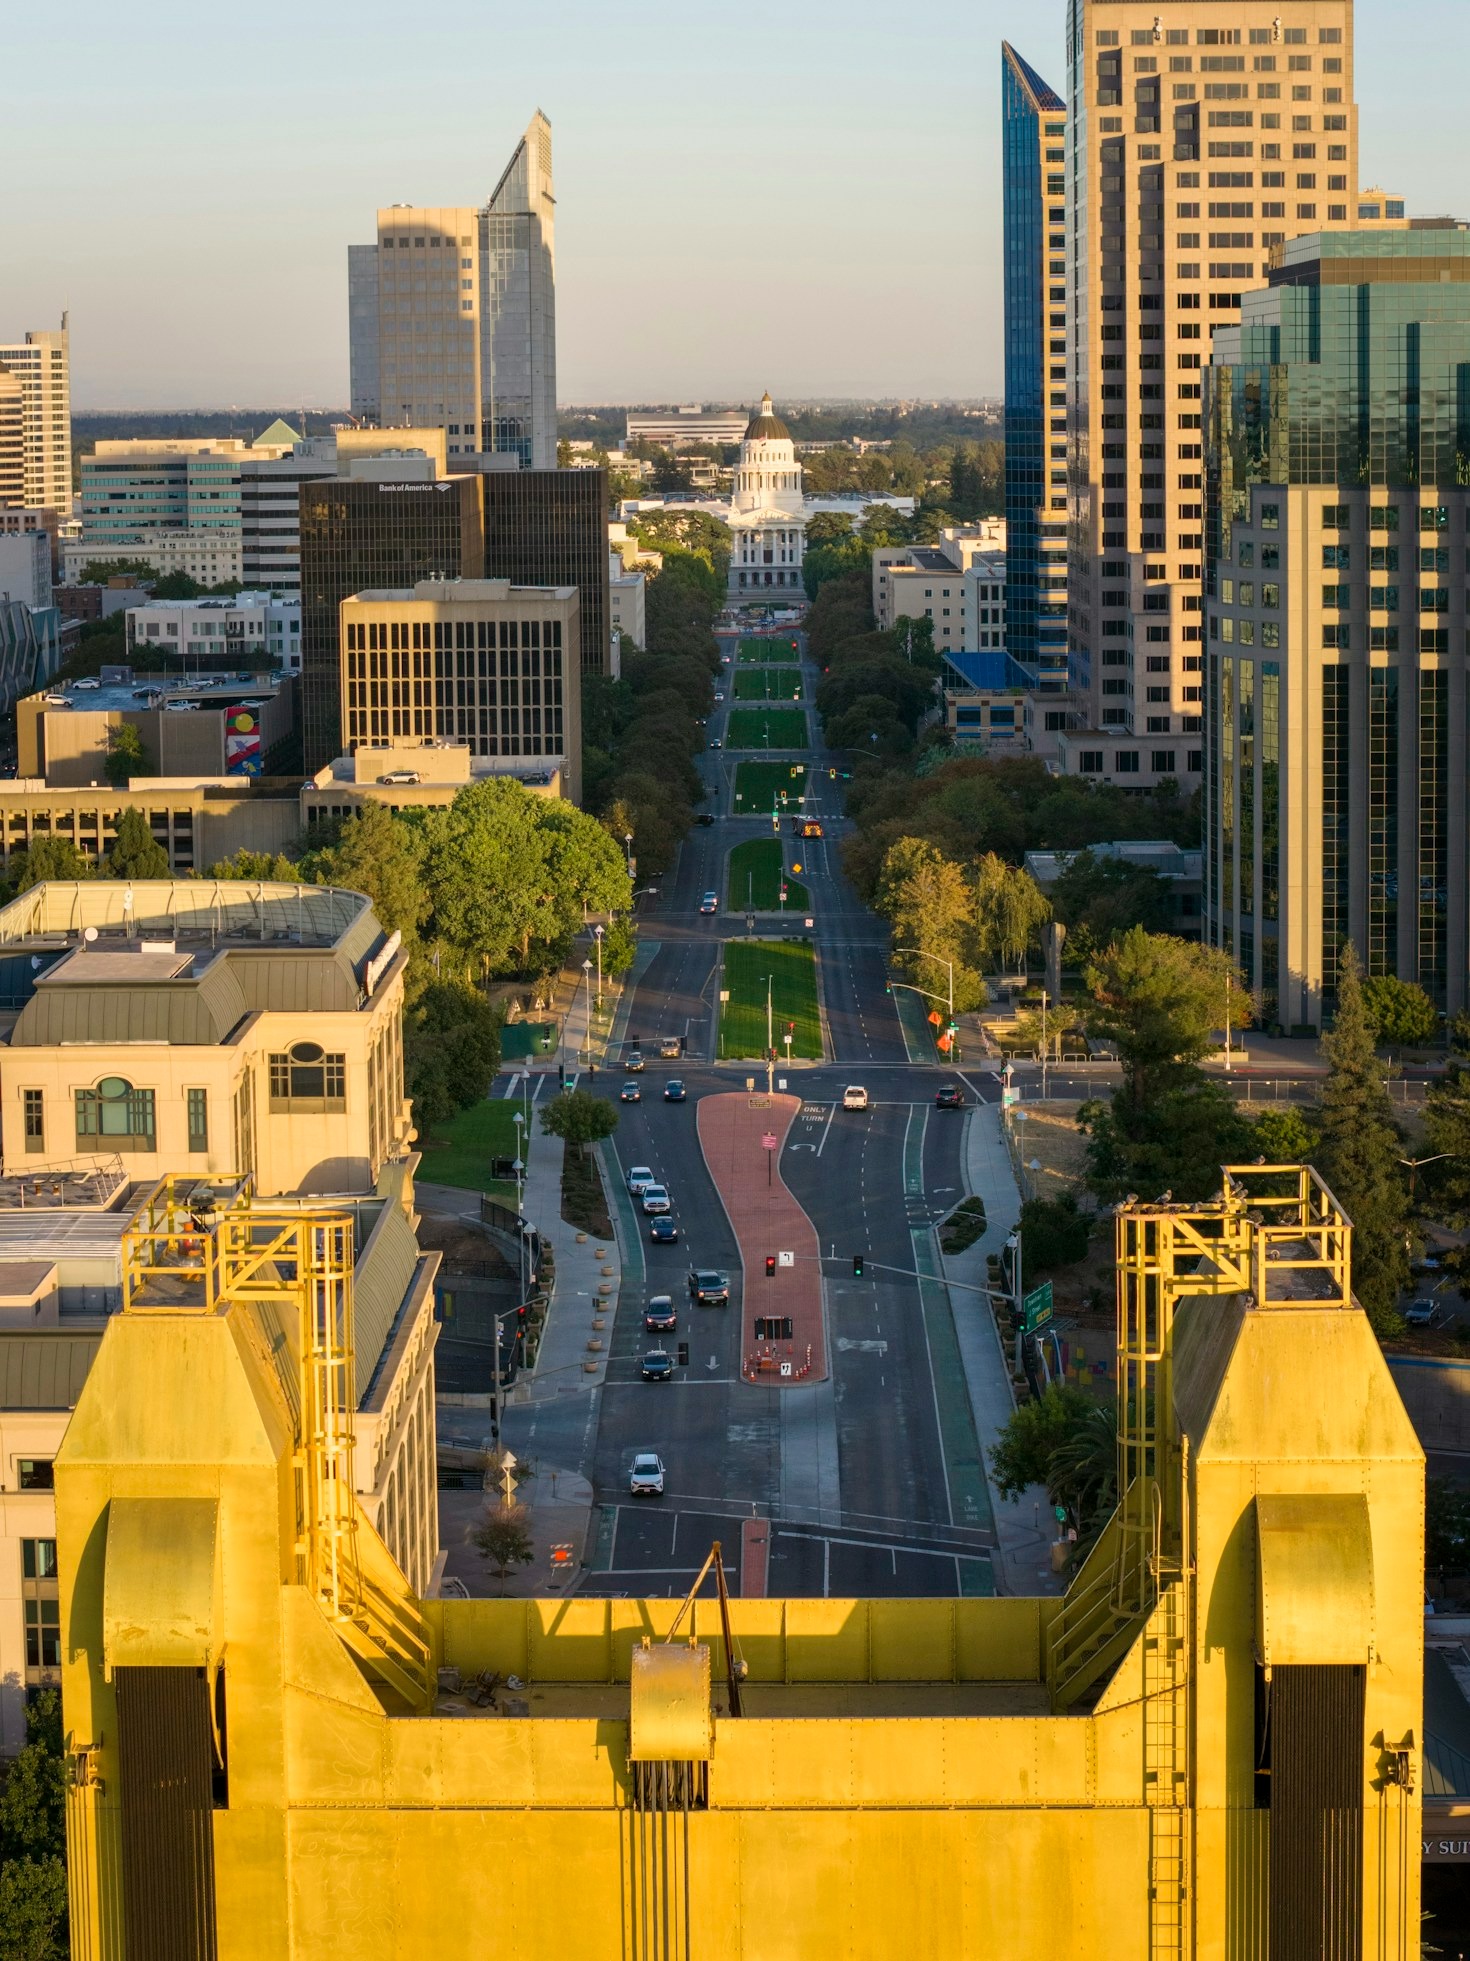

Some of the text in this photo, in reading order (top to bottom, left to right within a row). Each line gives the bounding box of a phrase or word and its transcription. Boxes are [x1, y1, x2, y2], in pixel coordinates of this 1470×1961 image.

[397, 484, 404, 492] of
[404, 484, 433, 492] America
[1439, 1841, 1470, 1855] SUI
